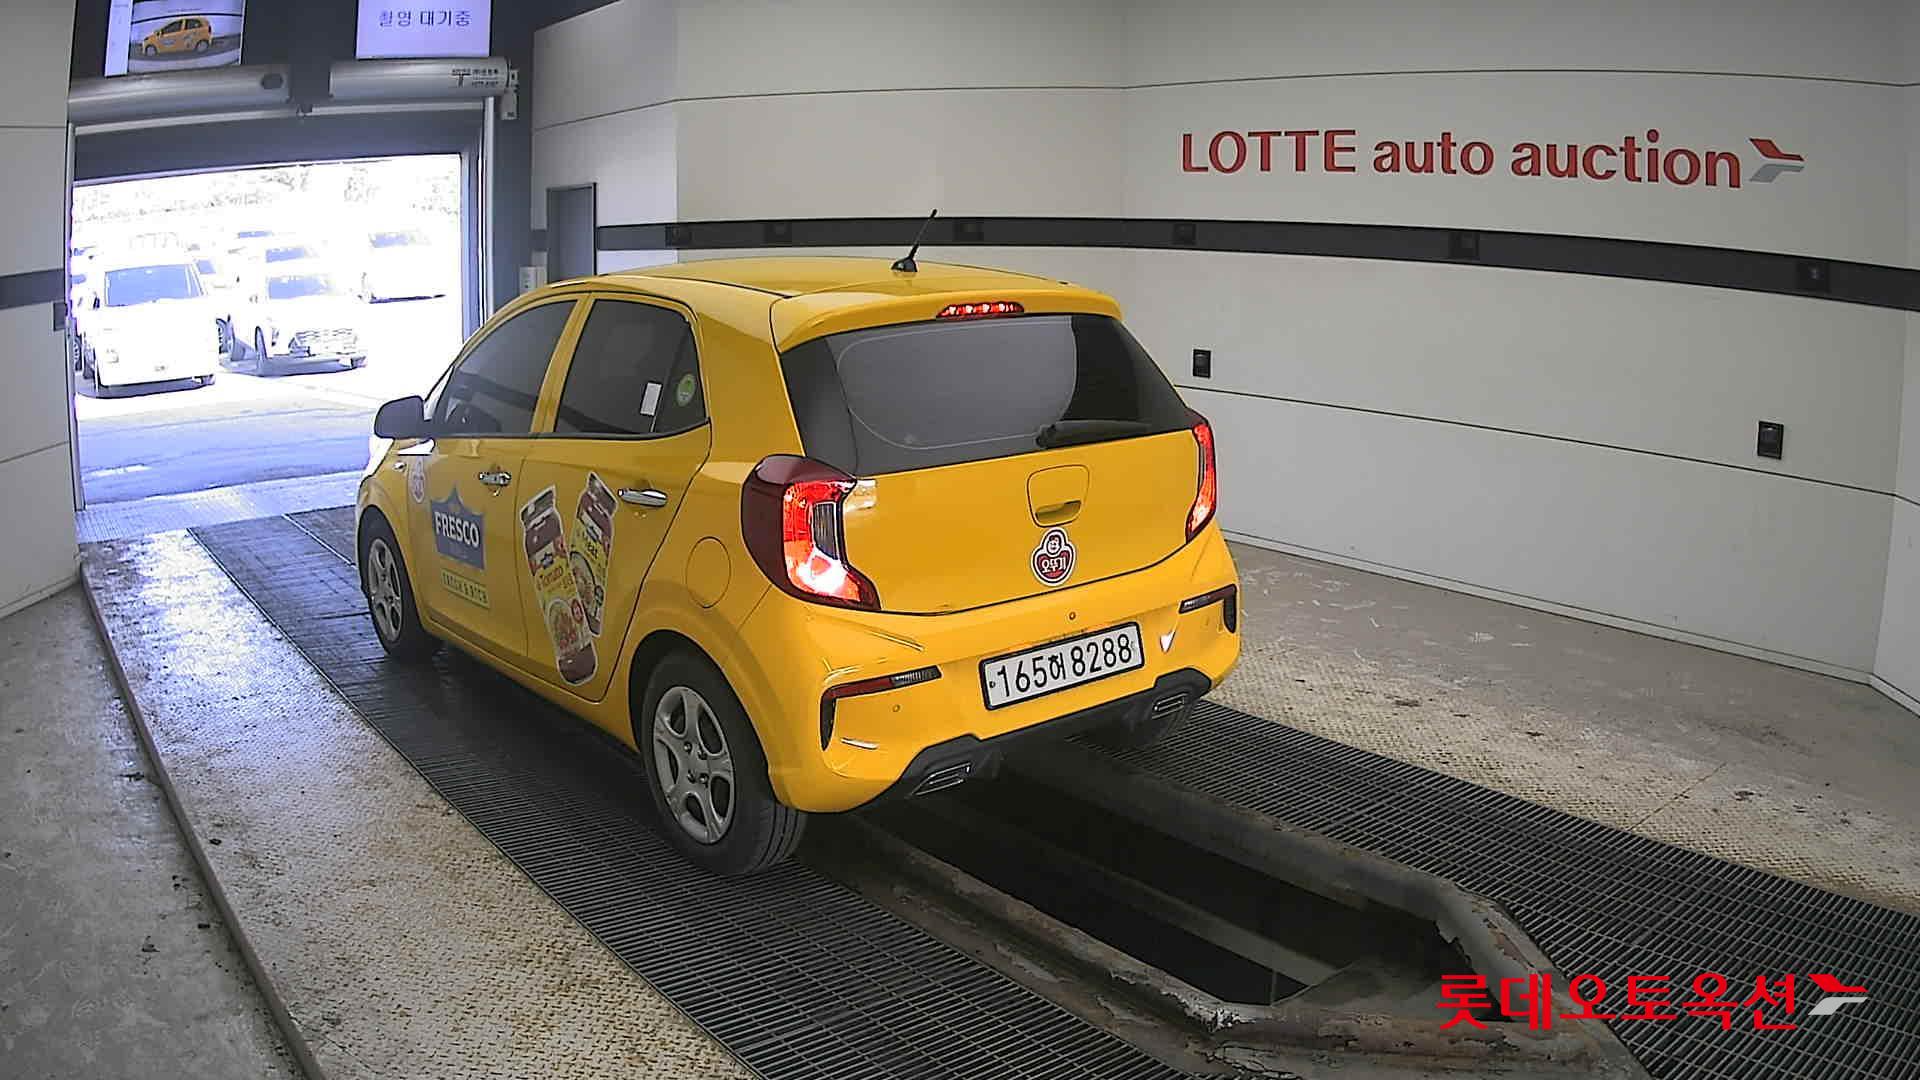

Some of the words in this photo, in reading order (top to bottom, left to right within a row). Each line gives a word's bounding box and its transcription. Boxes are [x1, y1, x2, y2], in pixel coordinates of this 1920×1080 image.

[419, 9, 472, 27] 대기중
[1181, 129, 1357, 174] LOTTE
[1373, 131, 1495, 176] auto
[1510, 128, 1741, 188] auction
[434, 511, 480, 548] FRESCO
